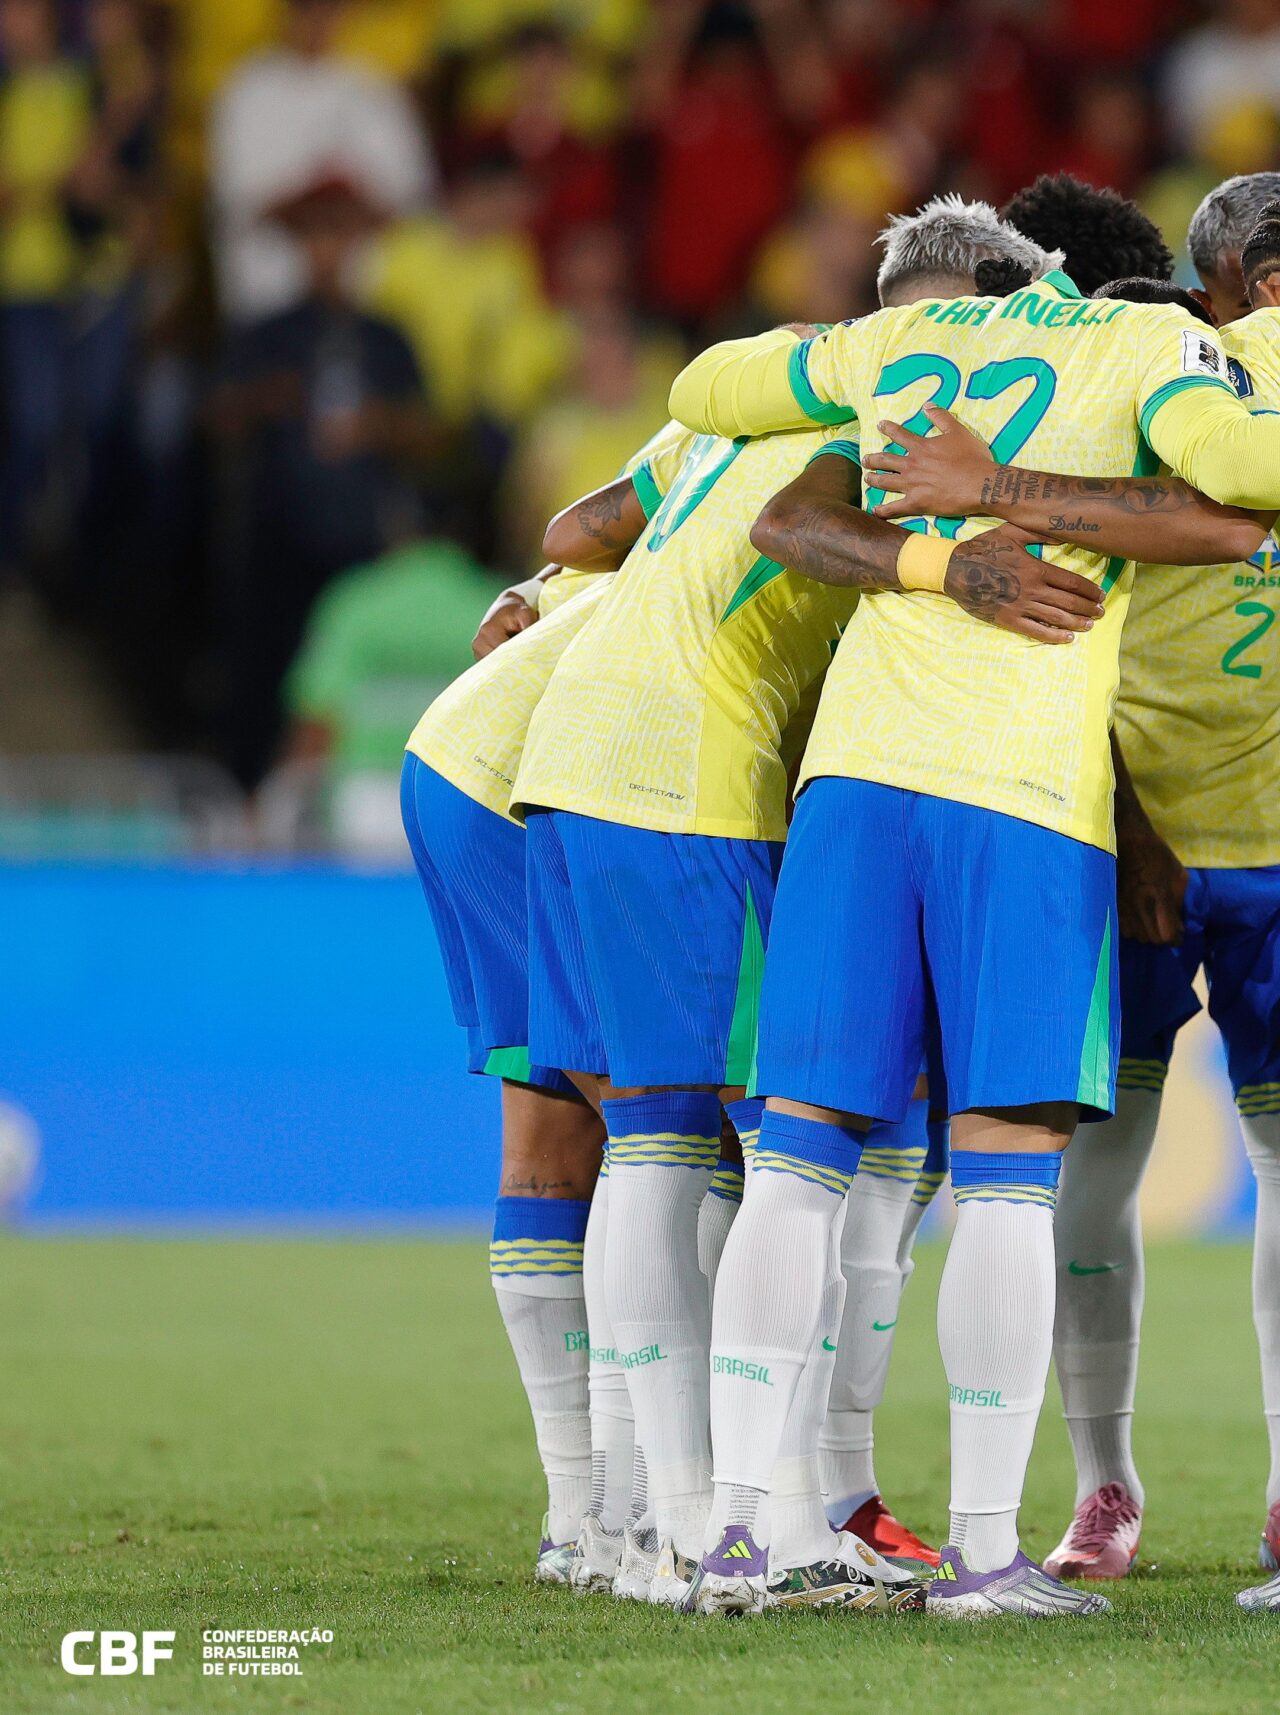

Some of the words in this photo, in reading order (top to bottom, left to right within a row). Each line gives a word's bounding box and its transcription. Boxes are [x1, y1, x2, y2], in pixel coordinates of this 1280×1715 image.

[1048, 515, 1102, 532] Dalva
[1221, 601, 1275, 679] 2
[712, 1355, 775, 1387] BRASIL
